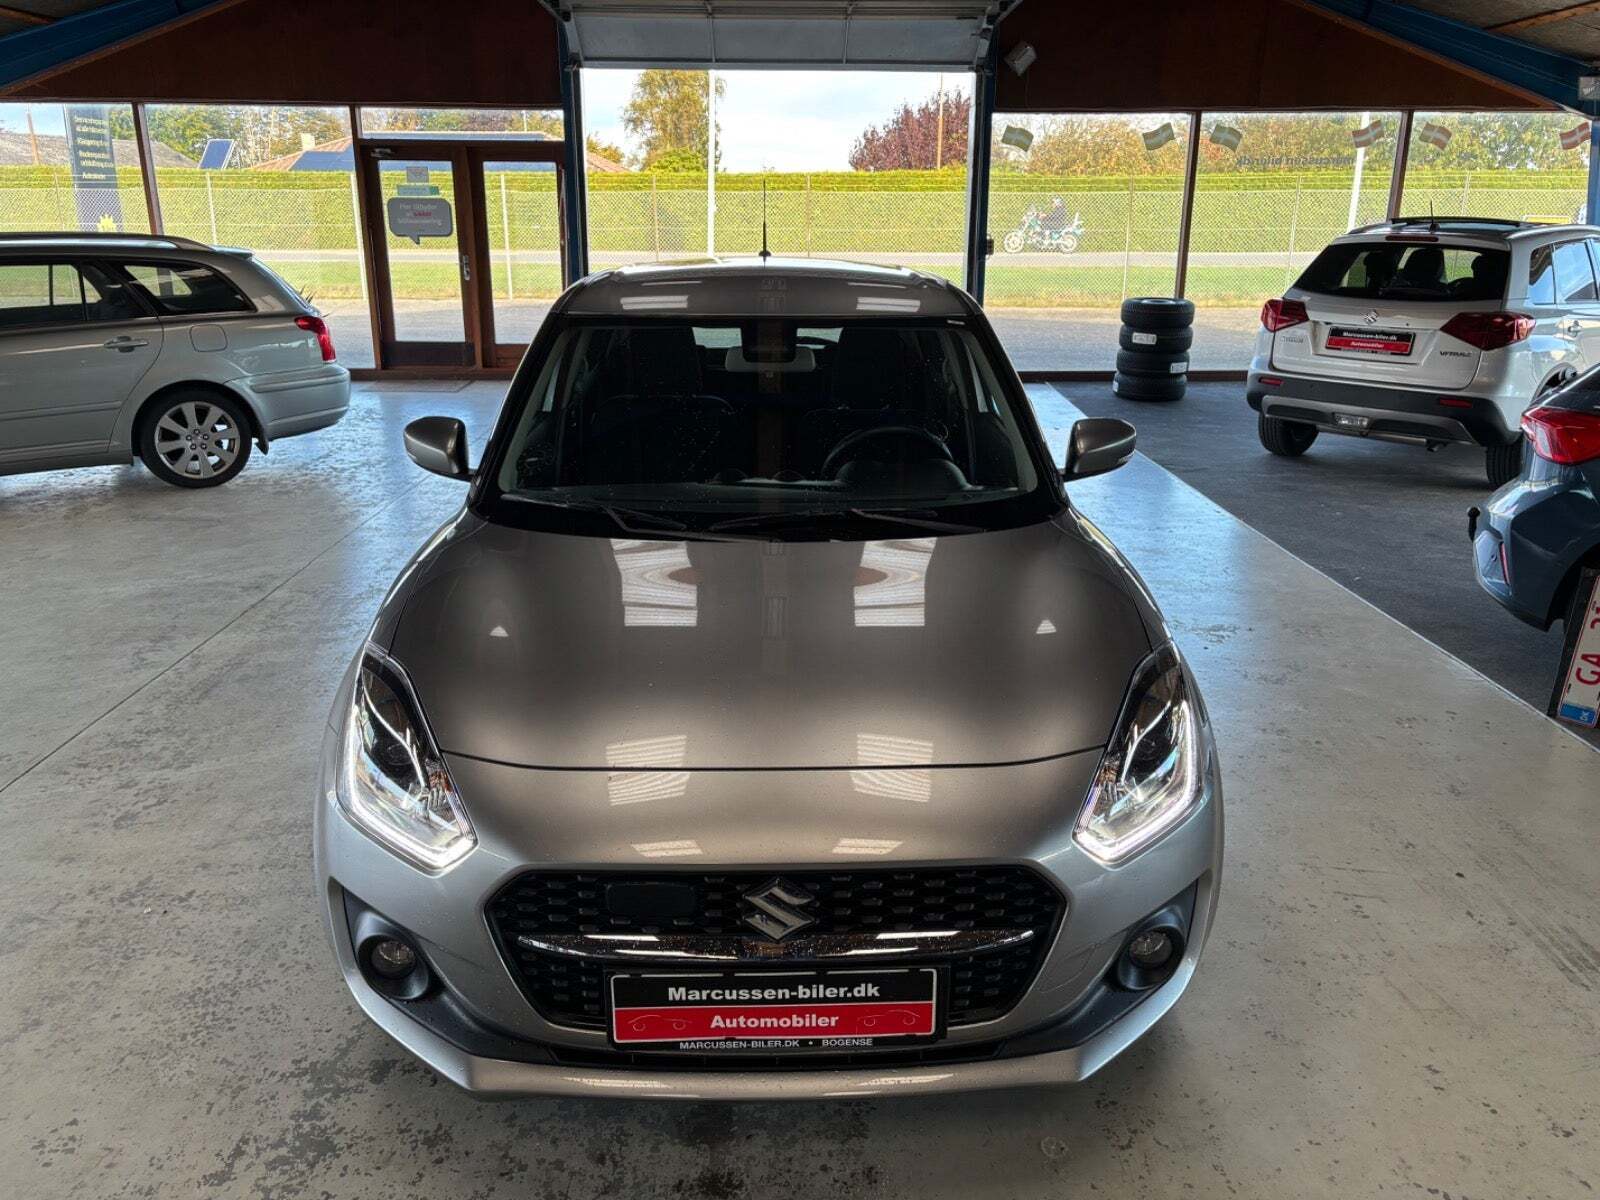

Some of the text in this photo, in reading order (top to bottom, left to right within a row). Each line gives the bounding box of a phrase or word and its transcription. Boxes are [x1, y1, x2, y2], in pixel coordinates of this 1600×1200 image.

[668, 983, 880, 1001] Marcussen-biler.dk
[710, 1014, 839, 1029] Automobiler
[679, 1038, 873, 1050] MARCUSSEN-BILER.DK BOGENSE
